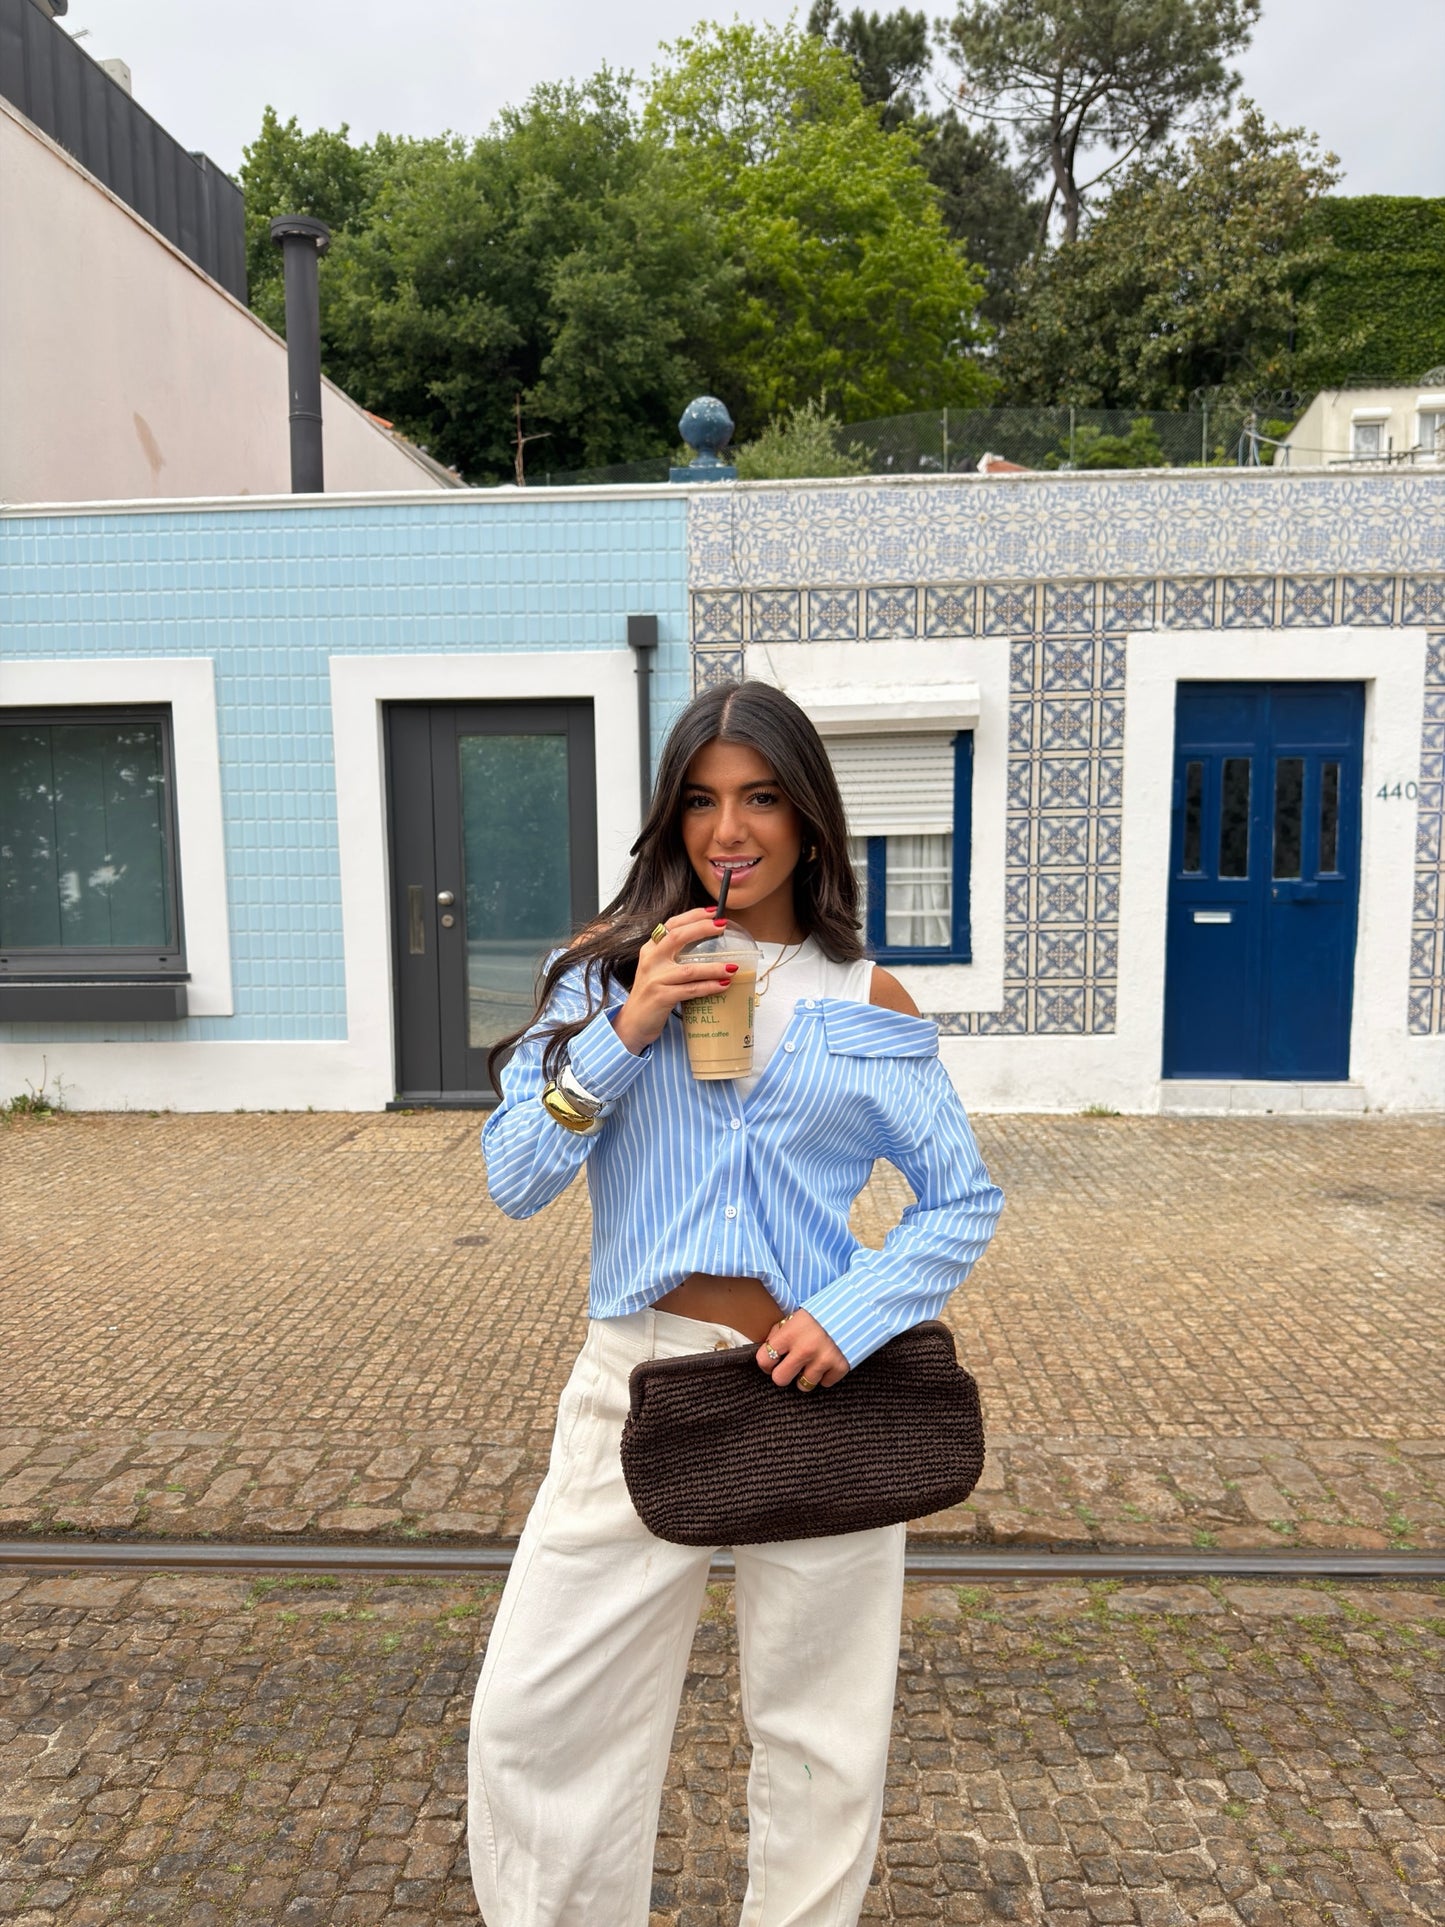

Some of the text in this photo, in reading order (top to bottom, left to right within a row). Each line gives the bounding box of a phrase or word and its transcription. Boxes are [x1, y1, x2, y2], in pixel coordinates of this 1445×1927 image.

[1376, 781, 1418, 801] 440
[685, 1015, 720, 1024] FOR ALL.
